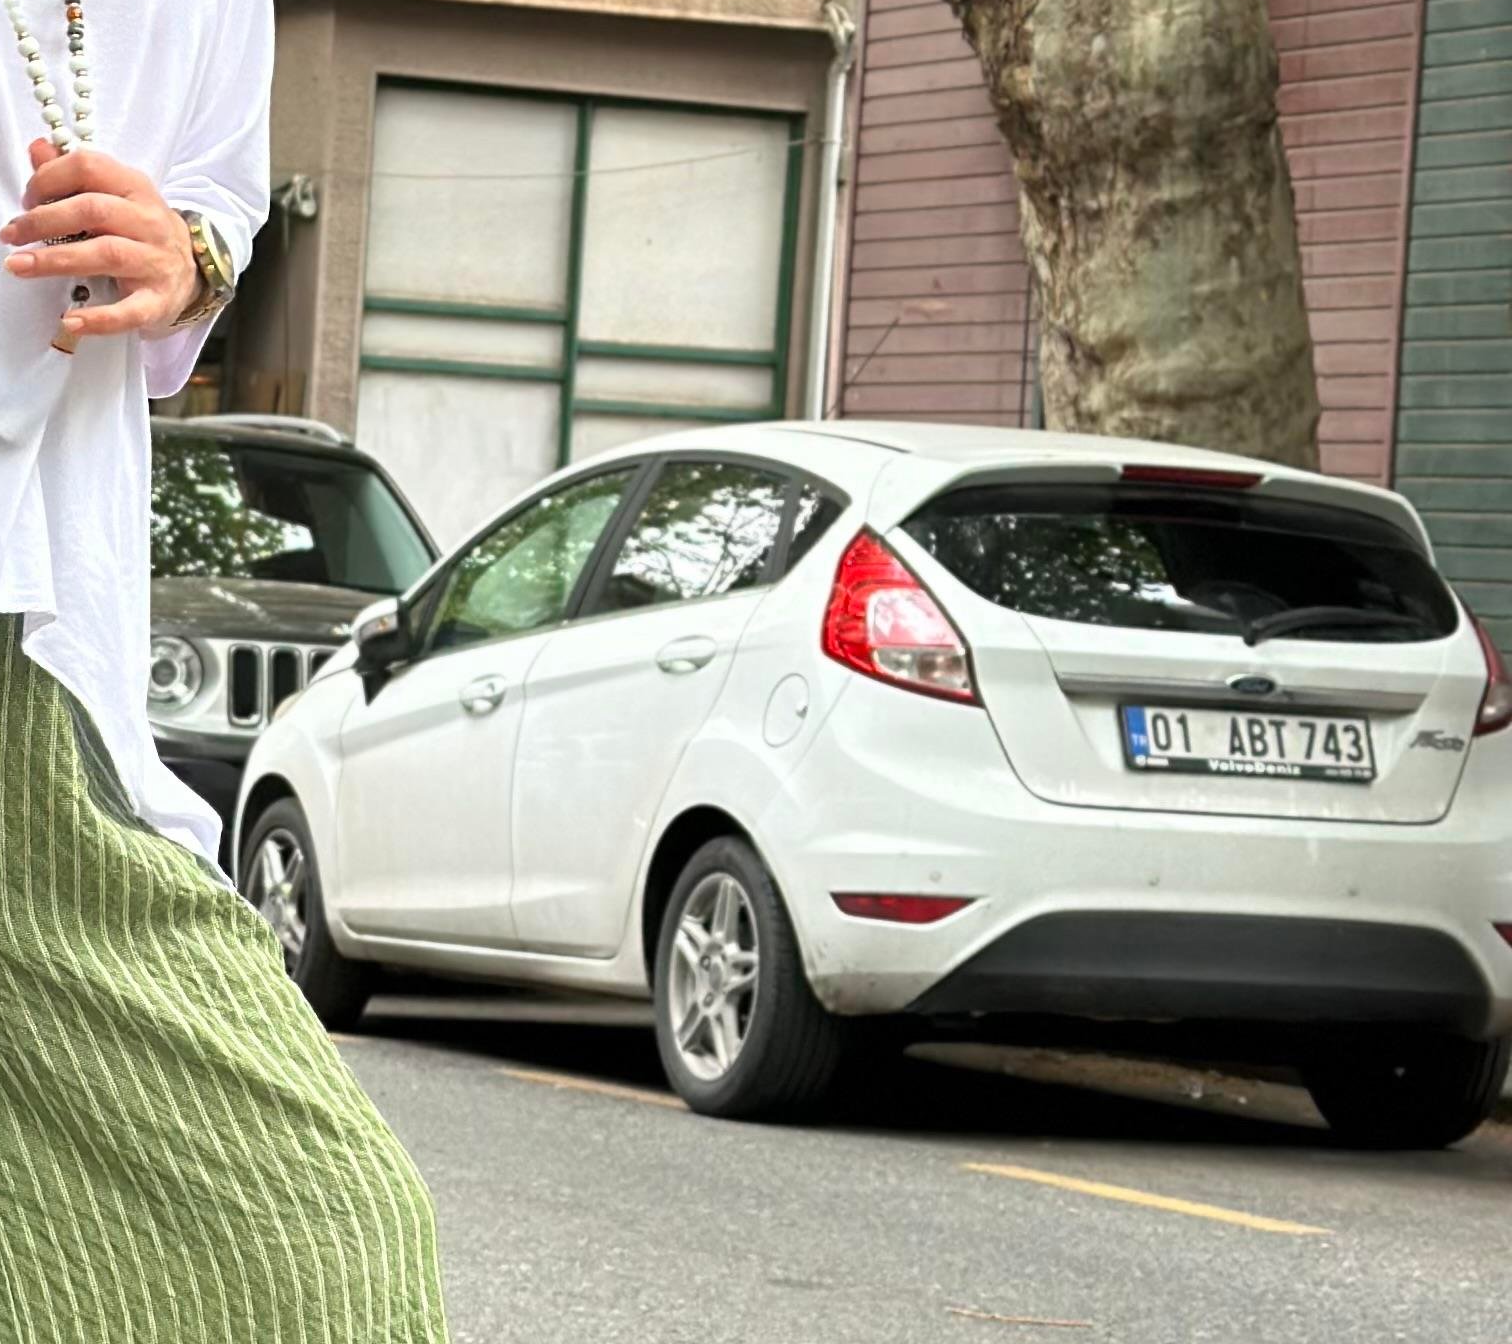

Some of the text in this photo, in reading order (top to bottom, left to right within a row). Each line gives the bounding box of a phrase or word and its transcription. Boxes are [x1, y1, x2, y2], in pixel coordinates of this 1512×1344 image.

[1151, 712, 1364, 762] 01 ABT 743
